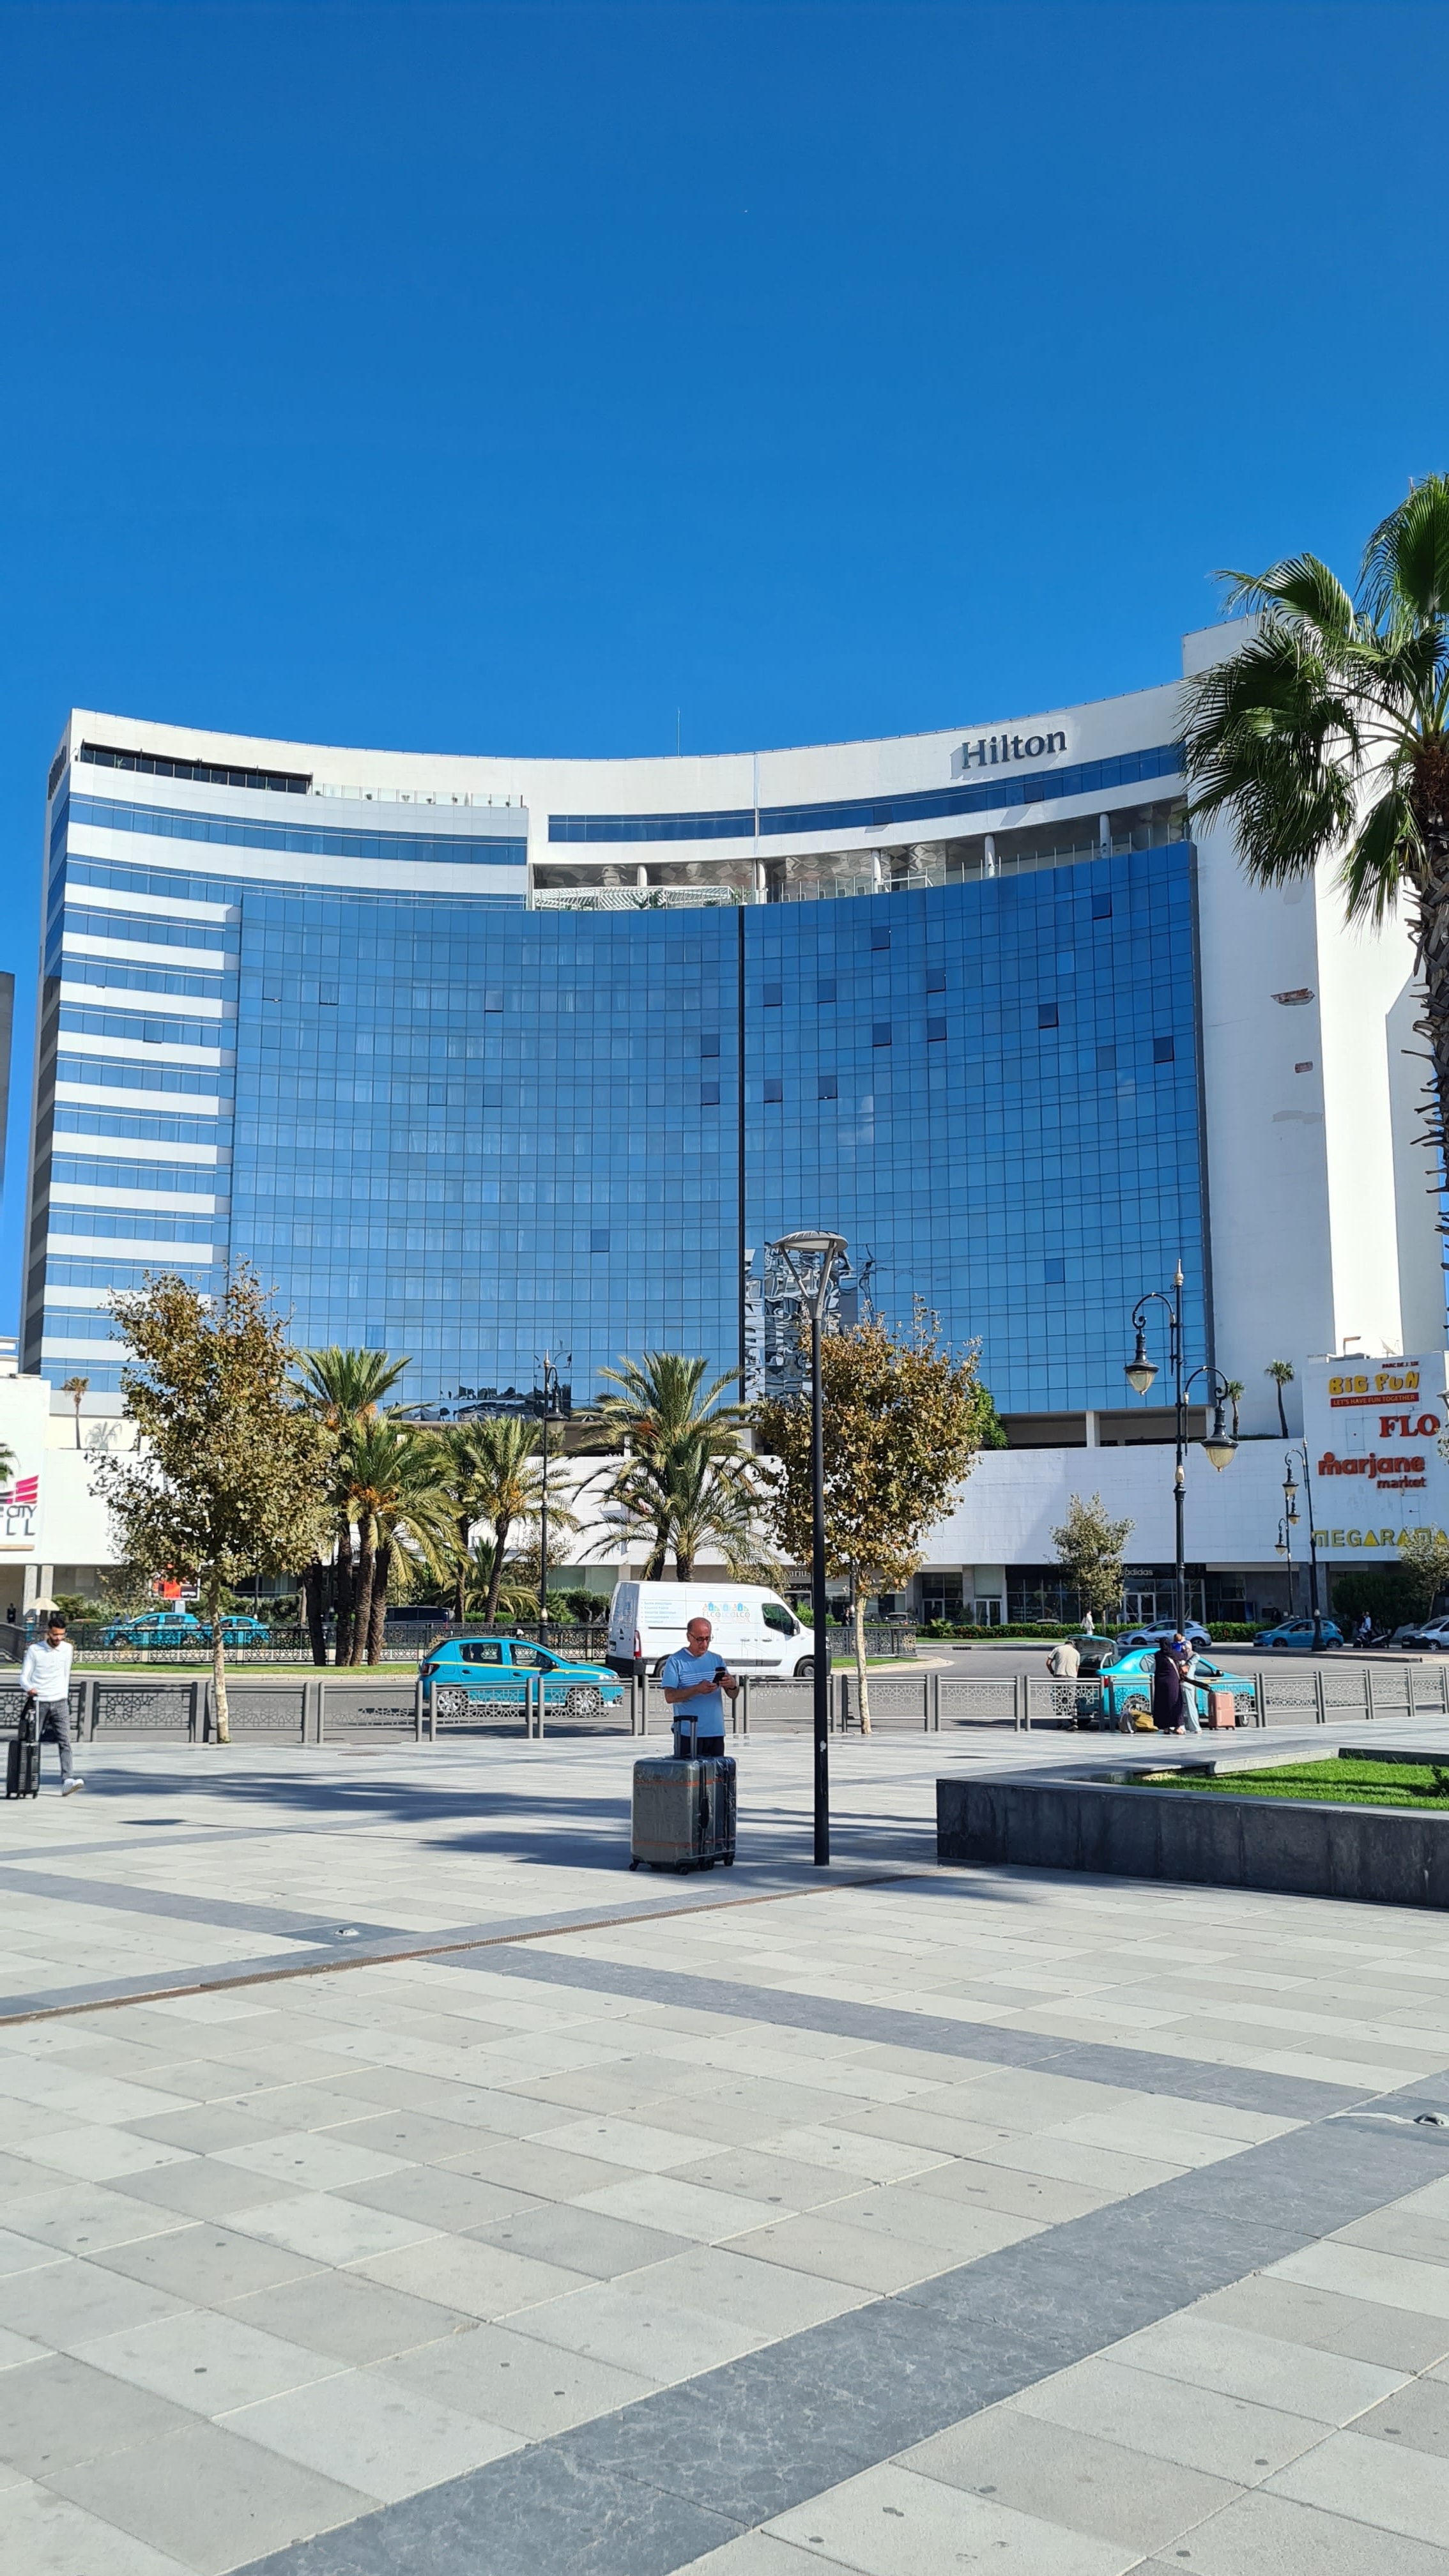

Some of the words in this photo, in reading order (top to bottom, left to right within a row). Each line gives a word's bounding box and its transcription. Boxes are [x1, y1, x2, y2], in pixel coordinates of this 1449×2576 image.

[962, 731, 1067, 769] Hilton
[1382, 1394, 1414, 1402] TOGETHER
[1379, 1414, 1441, 1438] FLO
[1318, 1452, 1425, 1479] marjane
[1377, 1475, 1427, 1489] market
[1124, 1567, 1153, 1576] adidas
